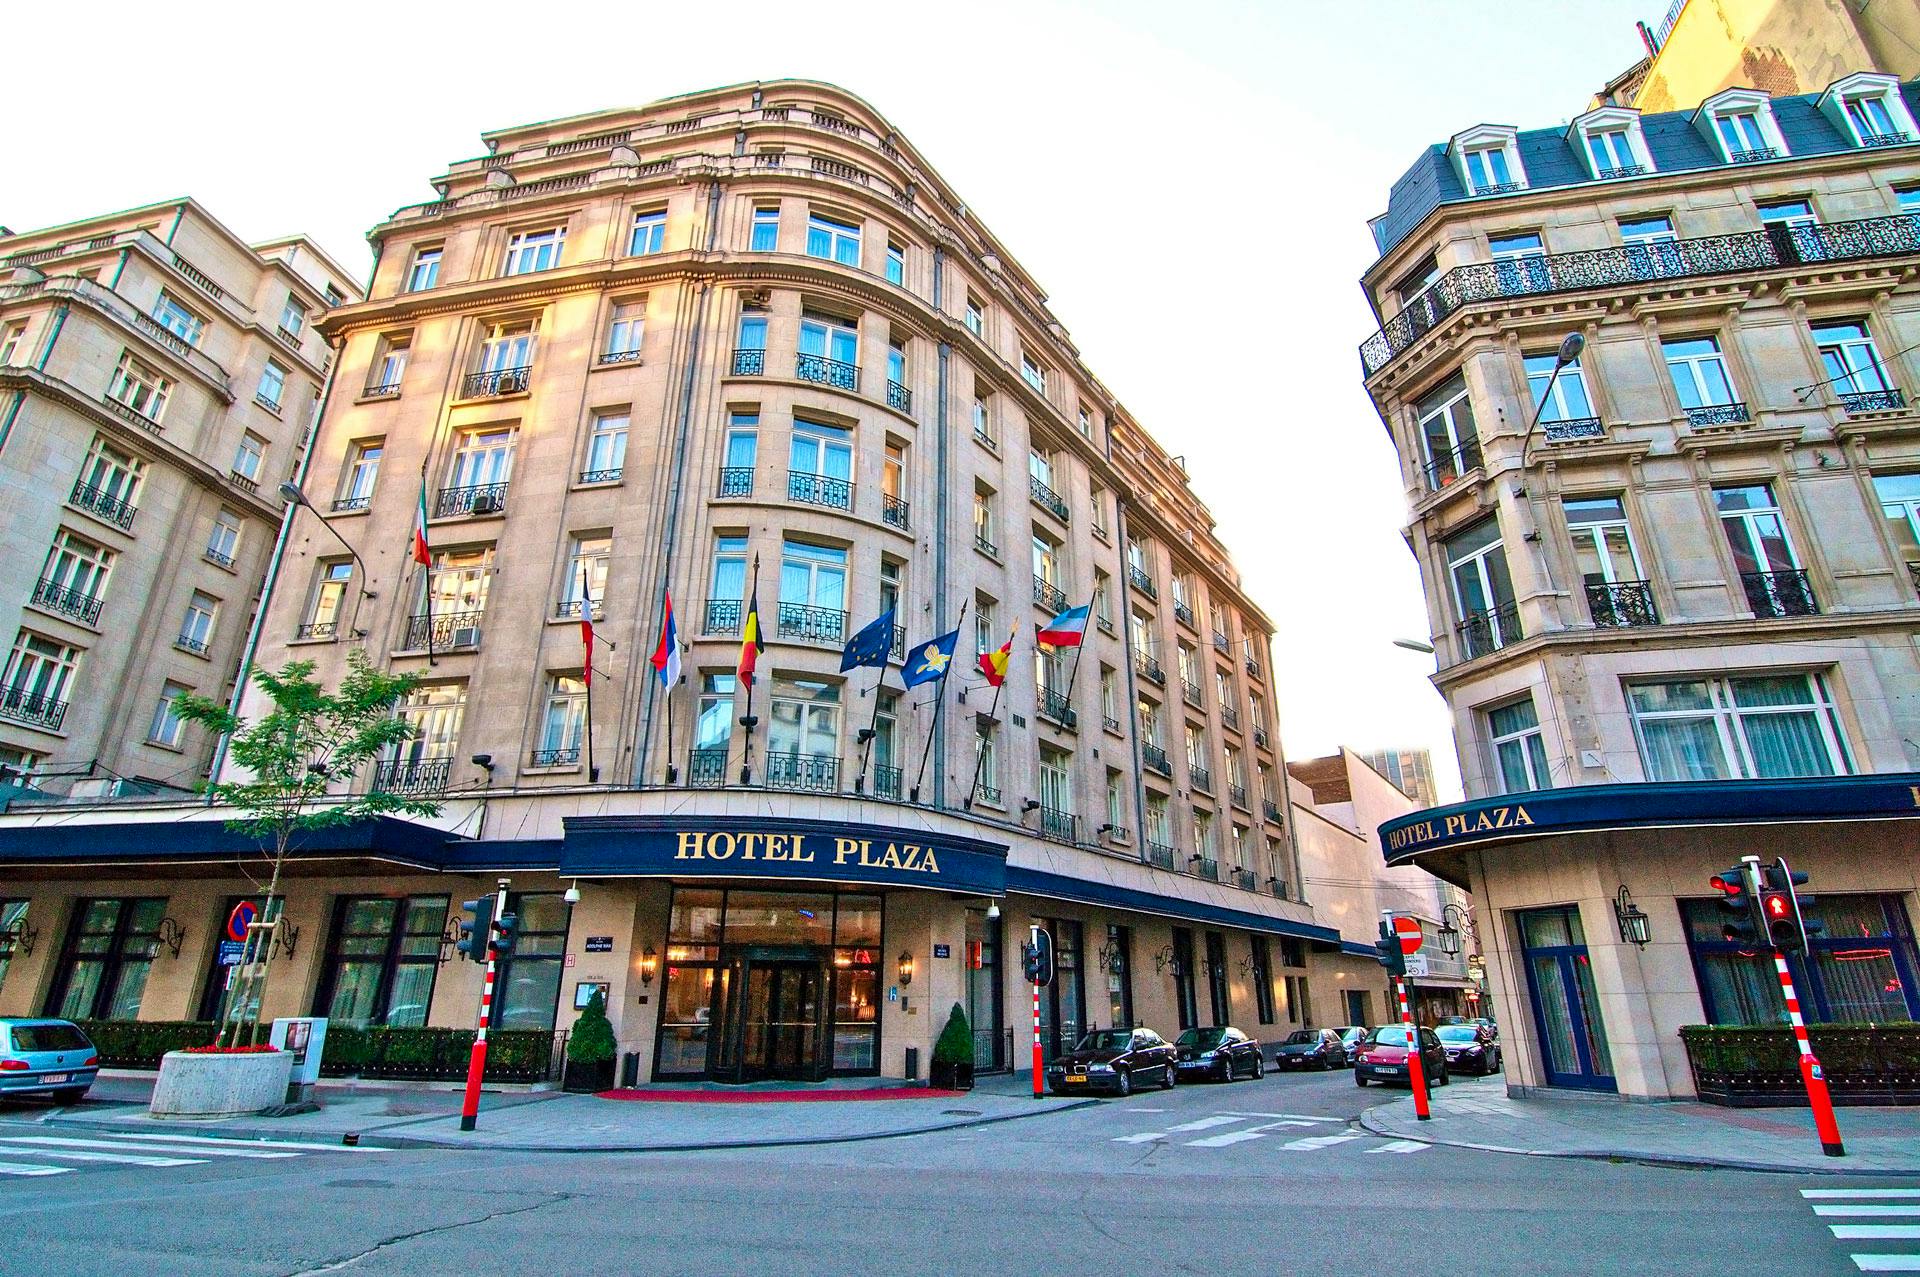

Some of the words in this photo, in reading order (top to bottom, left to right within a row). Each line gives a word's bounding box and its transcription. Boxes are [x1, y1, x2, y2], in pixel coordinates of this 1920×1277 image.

[1388, 820, 1440, 850] HOTEL
[1444, 805, 1535, 836] PLAZA
[674, 832, 815, 863] HOTEL
[832, 837, 940, 873] PLAZA
